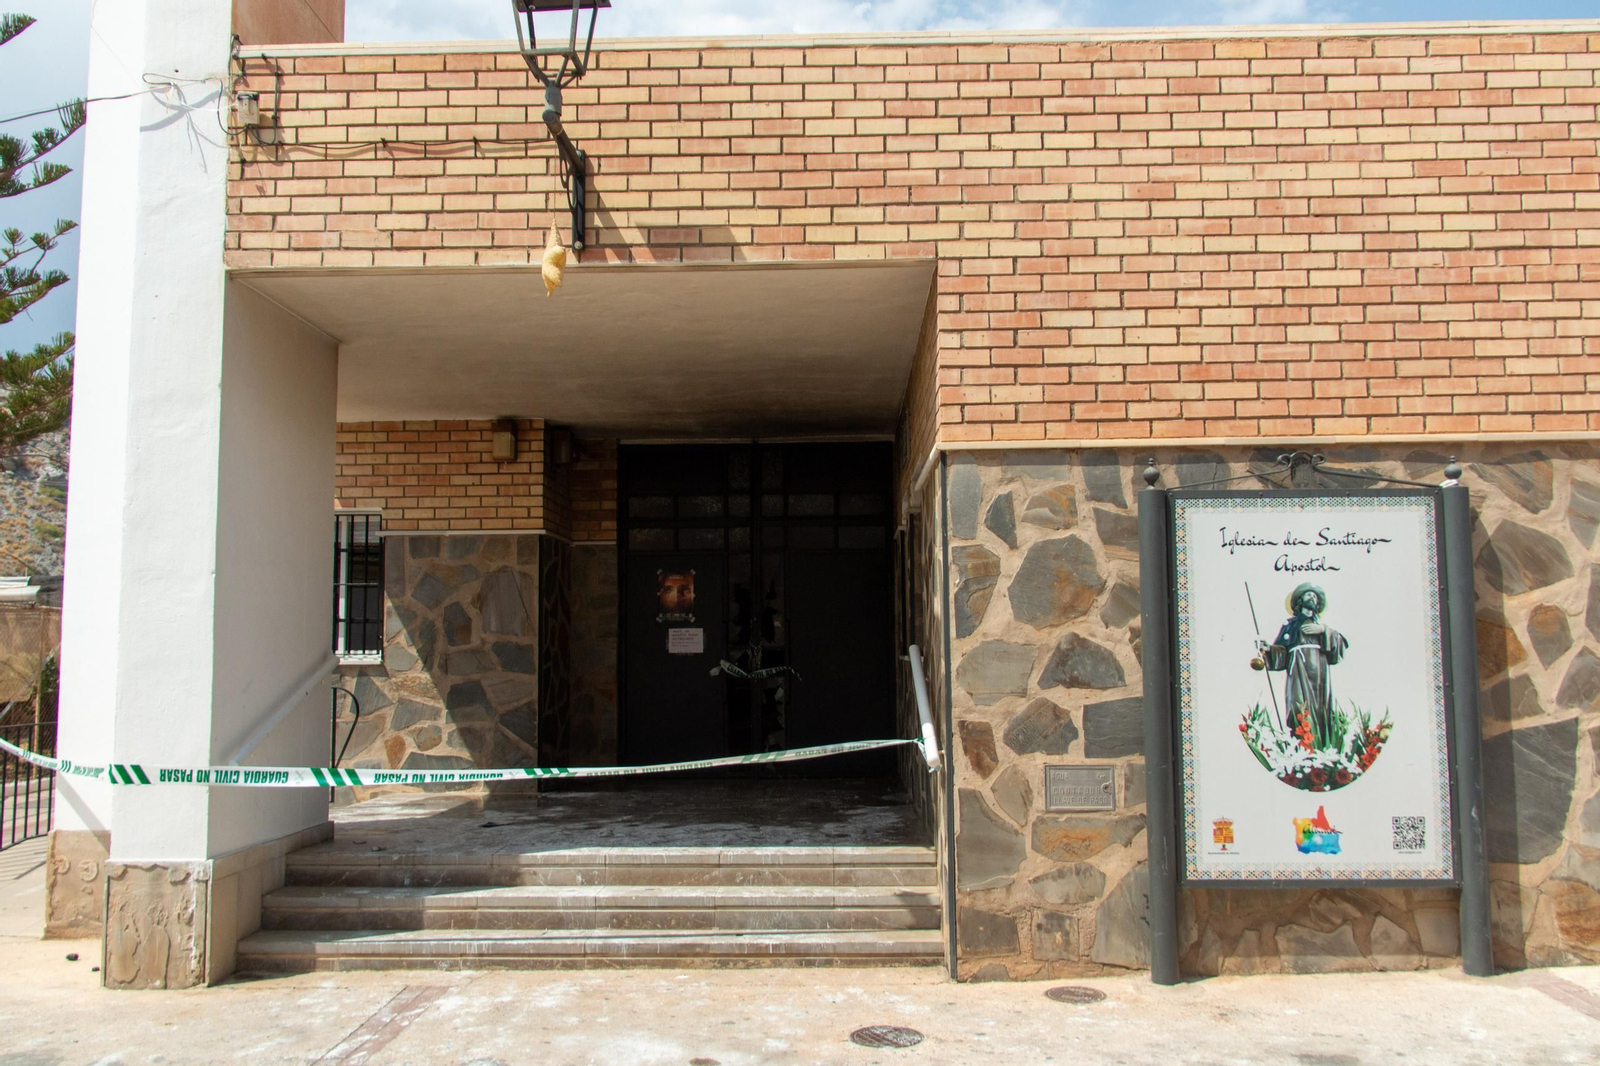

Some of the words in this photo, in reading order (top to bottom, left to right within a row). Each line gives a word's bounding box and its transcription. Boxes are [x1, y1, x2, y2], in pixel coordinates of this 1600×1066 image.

[1219, 526, 1278, 554] Iglesia
[1283, 531, 1311, 546] de
[1315, 527, 1392, 553] Santiago
[1274, 554, 1340, 576] Apostol
[159, 768, 193, 782] PASAR
[196, 769, 210, 783] NO
[214, 770, 240, 783] CIVIL
[243, 770, 289, 784] GUARDIA
[373, 773, 408, 783] PASAR
